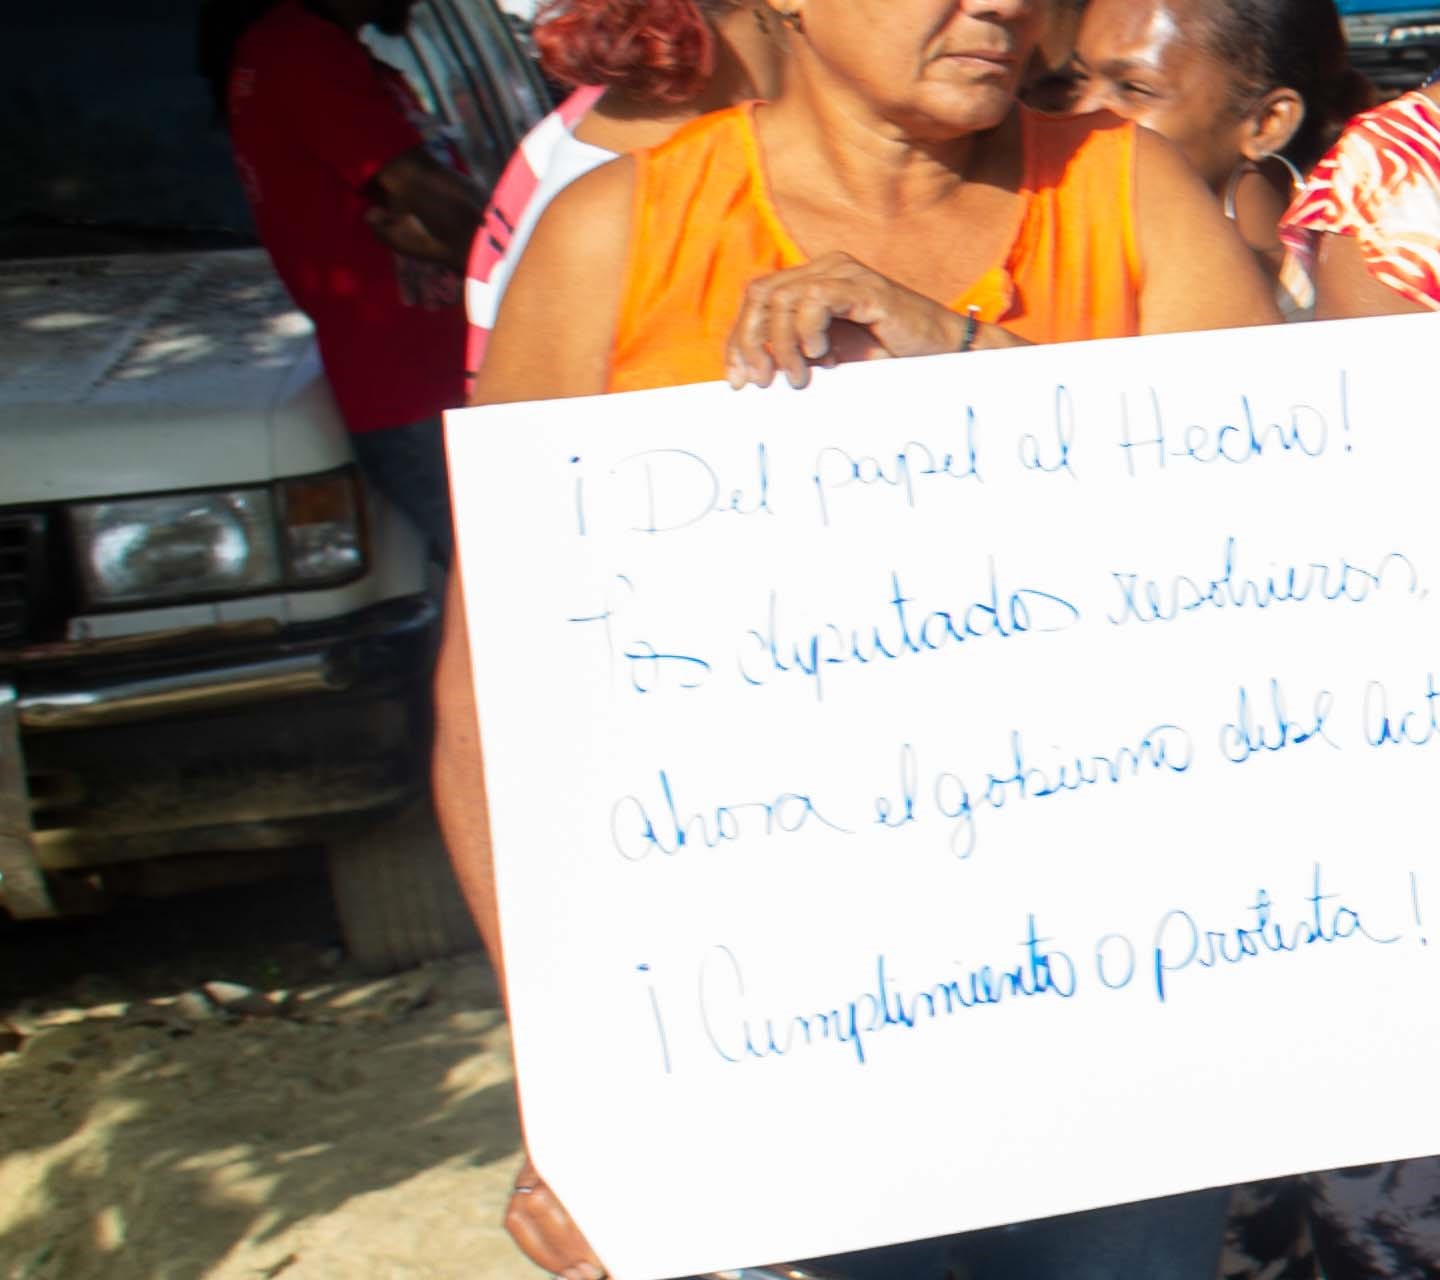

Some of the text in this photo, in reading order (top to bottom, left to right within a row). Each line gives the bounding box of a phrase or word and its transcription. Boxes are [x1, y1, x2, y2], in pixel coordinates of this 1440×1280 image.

[813, 405, 985, 527] papel
[1017, 382, 1081, 482] al
[1117, 368, 1355, 478] Hecho!
[738, 554, 1080, 703] diputados
[1217, 676, 1343, 766] debe
